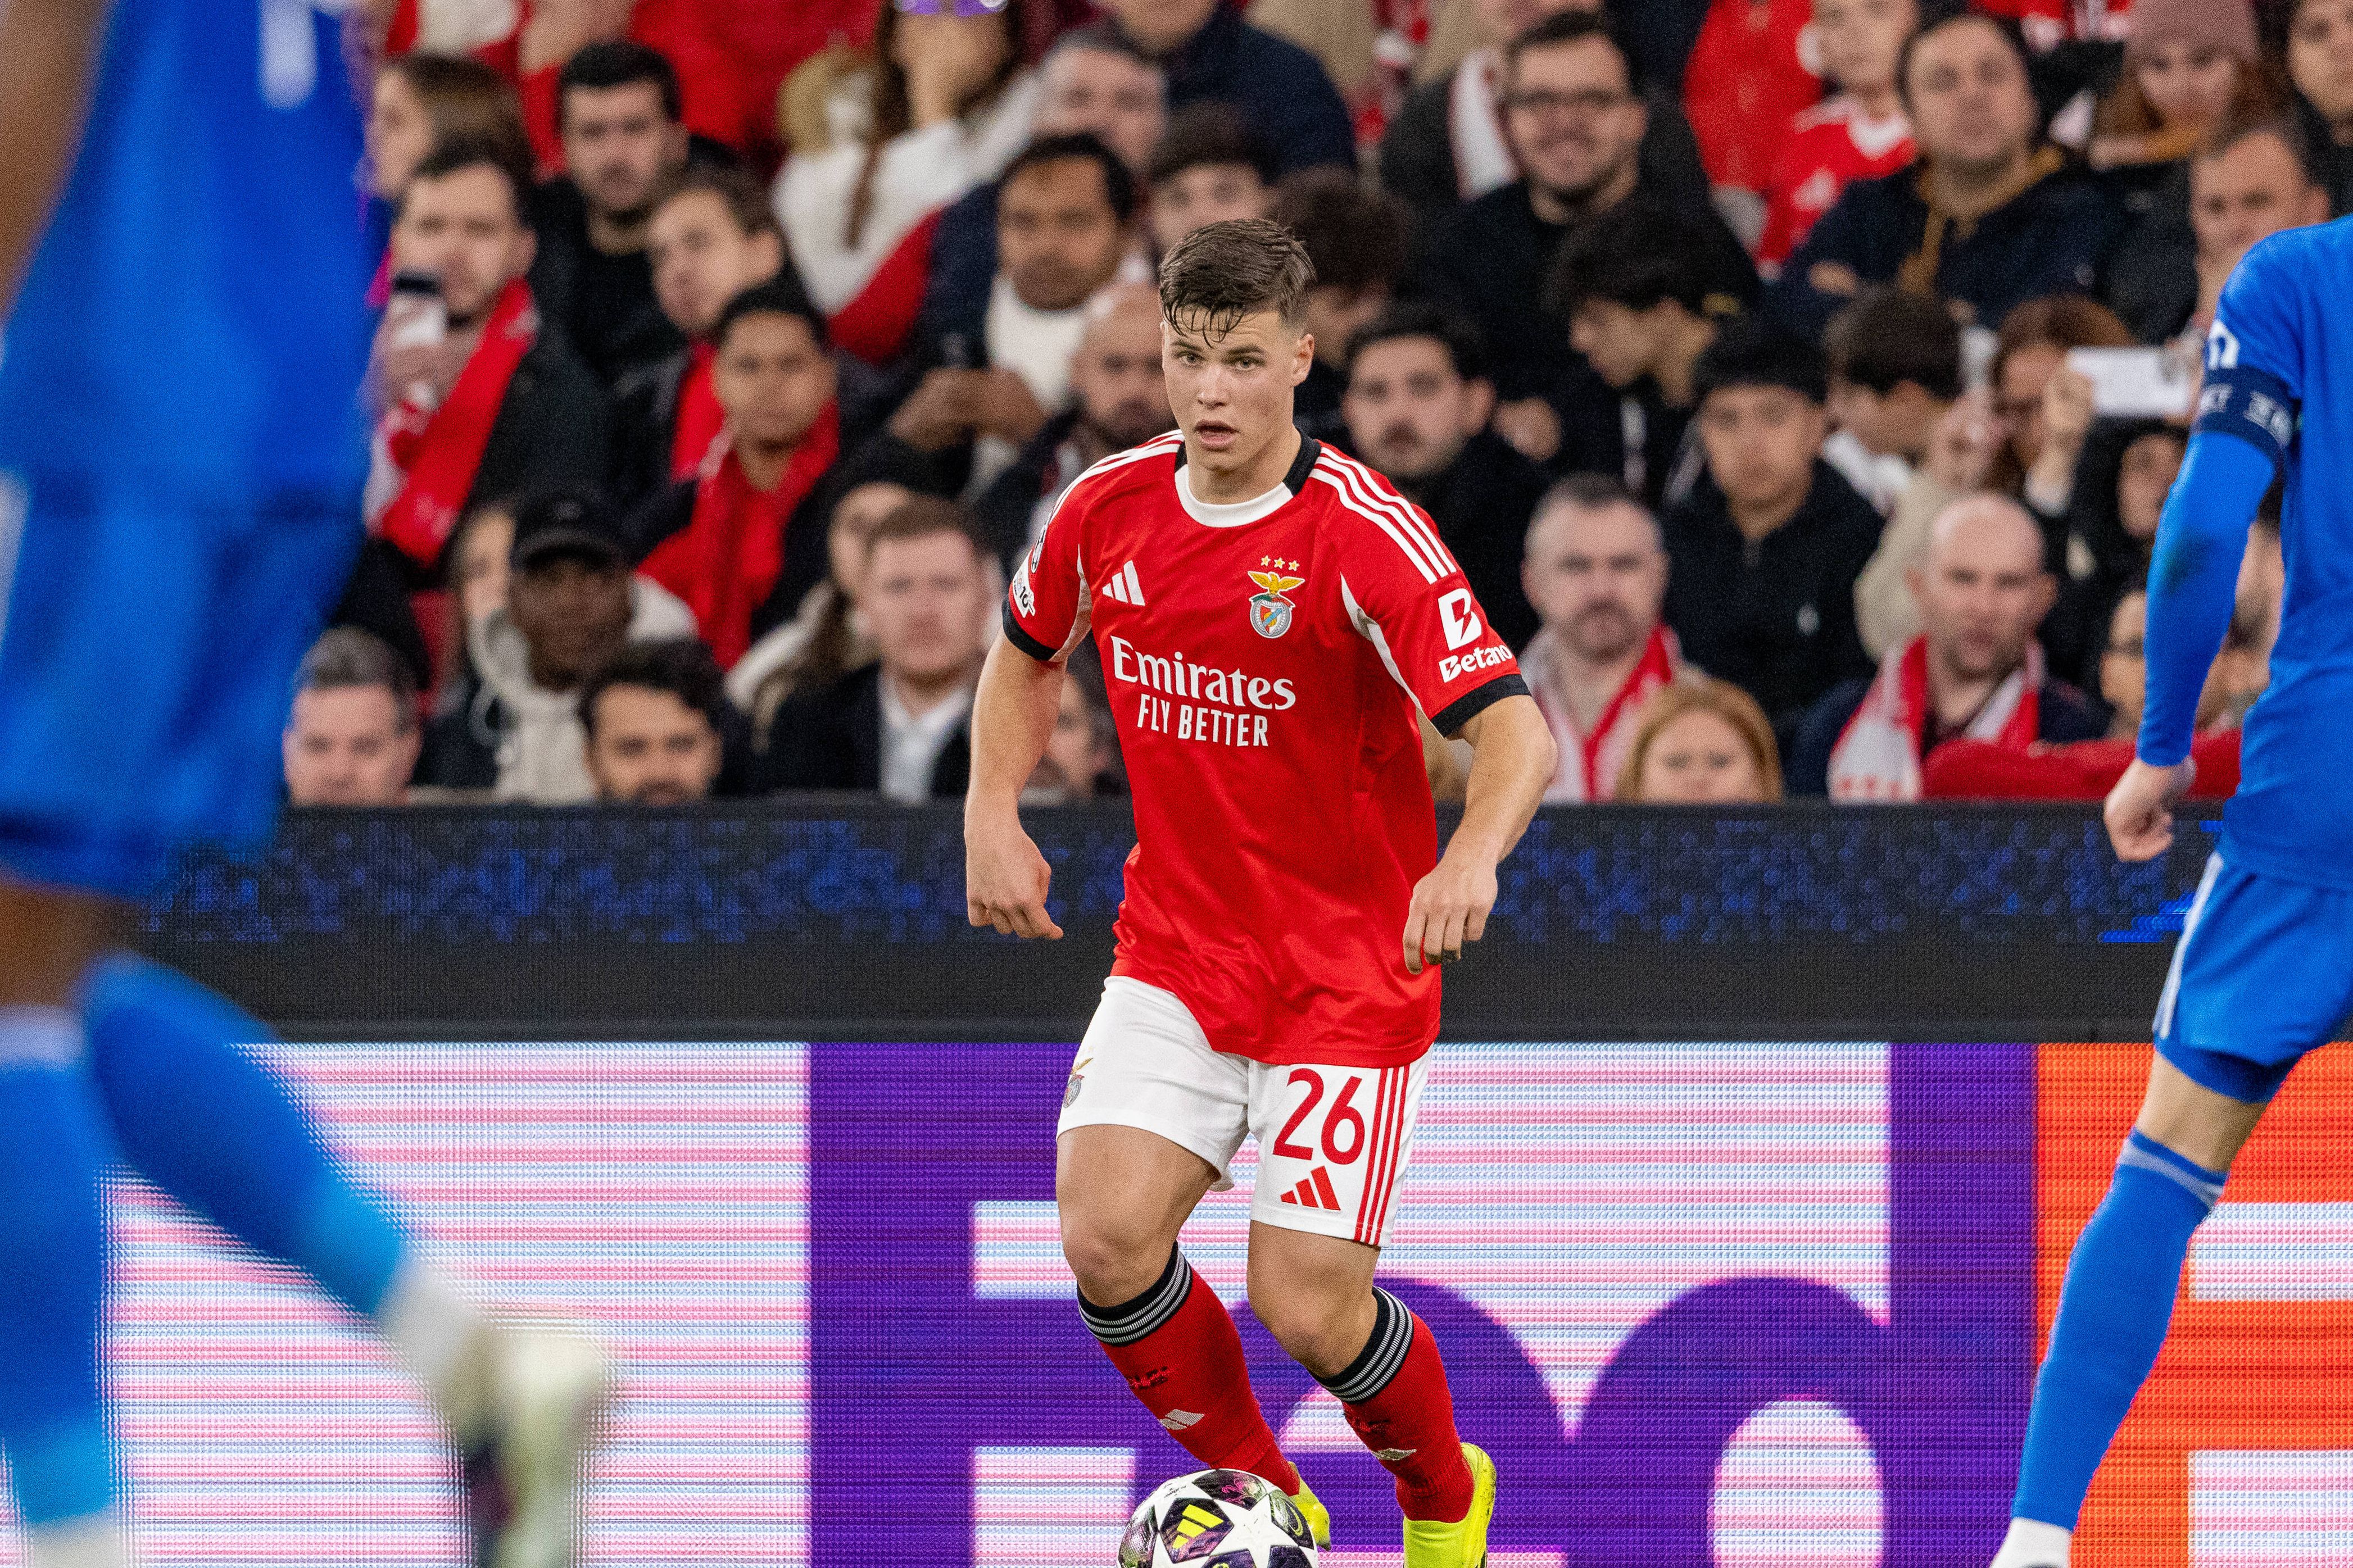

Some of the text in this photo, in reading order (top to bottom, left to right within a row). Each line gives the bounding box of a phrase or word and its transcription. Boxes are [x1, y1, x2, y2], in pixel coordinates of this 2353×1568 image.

[1110, 635, 1296, 711] Emirates
[1438, 644, 1514, 684] Betano
[1137, 693, 1269, 747] FLY BETTER
[1272, 1067, 1366, 1165] 26
